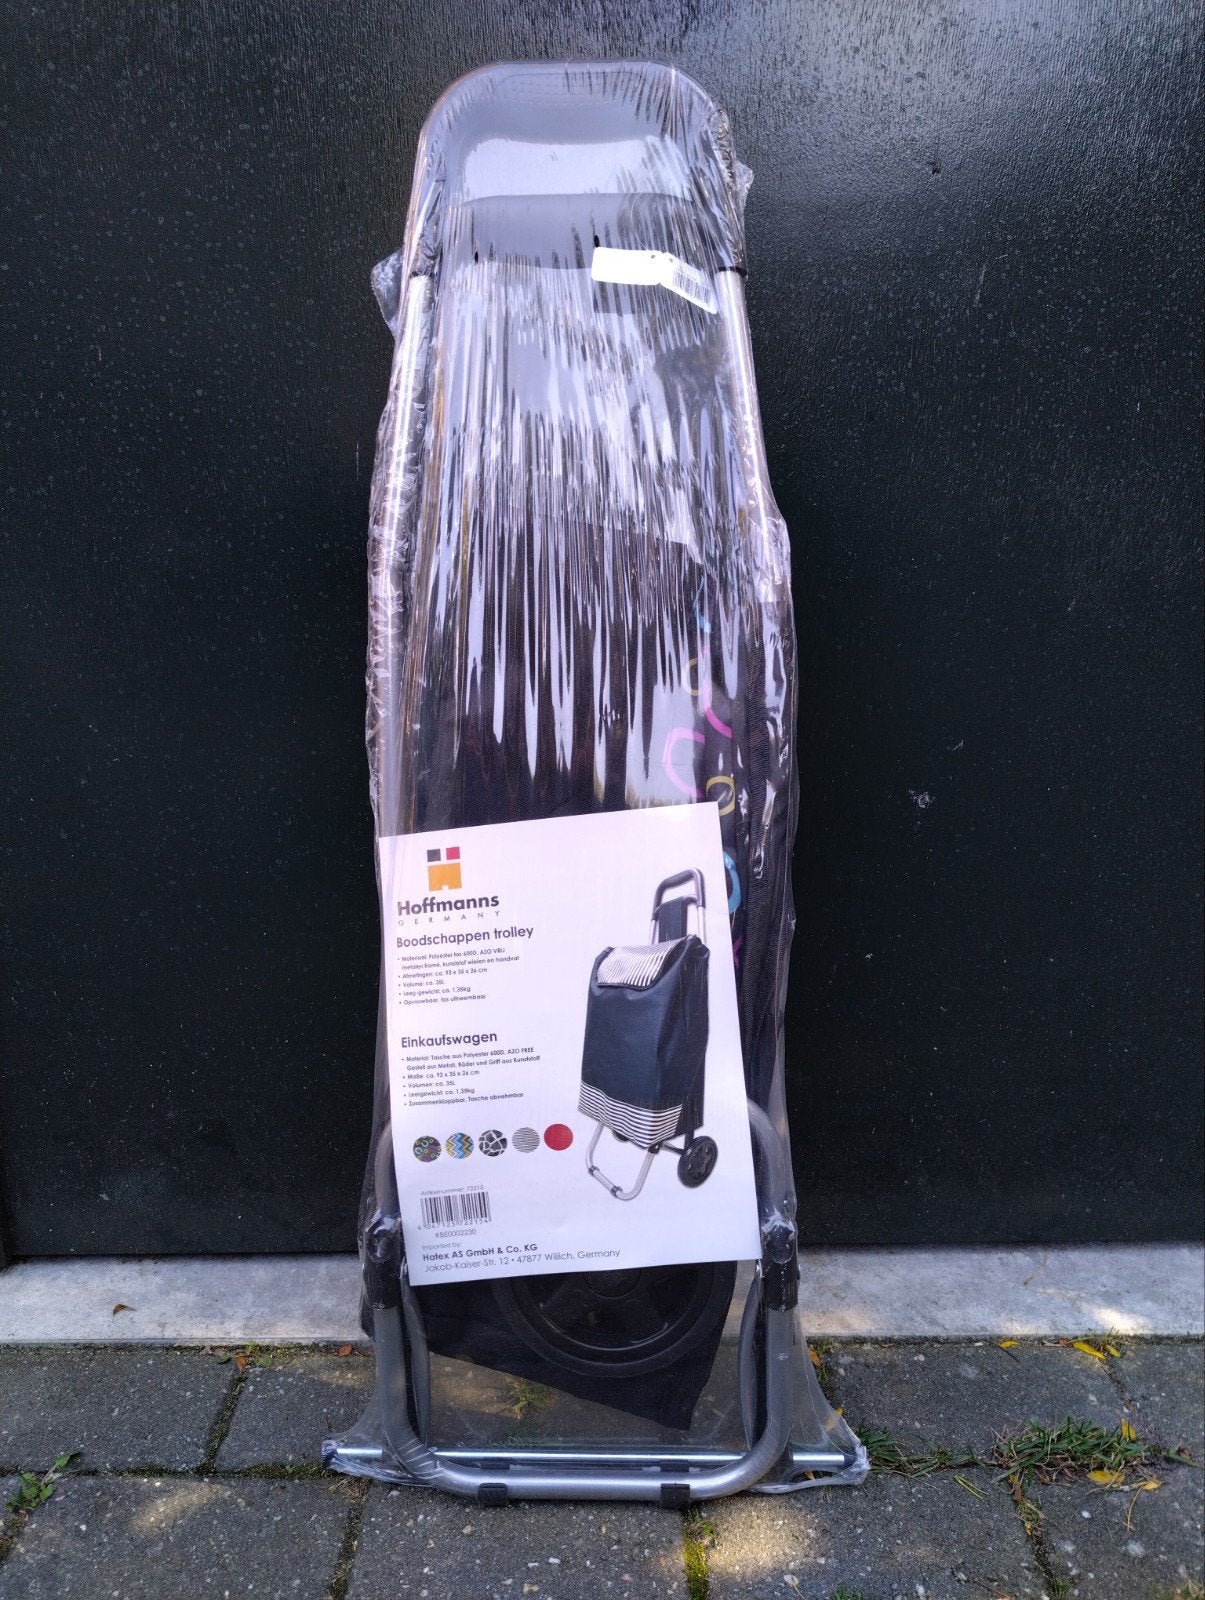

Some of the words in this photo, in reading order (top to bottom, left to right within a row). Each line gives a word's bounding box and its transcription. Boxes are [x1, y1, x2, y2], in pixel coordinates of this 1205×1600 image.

[397, 895, 500, 916] Hoffmanns
[398, 910, 500, 926] GERMANY
[396, 931, 490, 948] Boodschappen
[493, 926, 534, 940] trolley
[401, 1033, 498, 1049] Einkaufswagen
[489, 1092, 524, 1100] abnehmbar
[422, 1253, 449, 1262] Hatex
[451, 1250, 464, 1259] AS
[466, 1247, 495, 1257] GmbH
[506, 1245, 522, 1253] Co.
[524, 1243, 538, 1251] KG
[423, 1259, 497, 1273] Jakob-Kaiser-Str.
[499, 1256, 510, 1265] 12
[516, 1254, 541, 1263] 47877
[545, 1251, 575, 1260] Willich,
[577, 1248, 621, 1259] Germany
